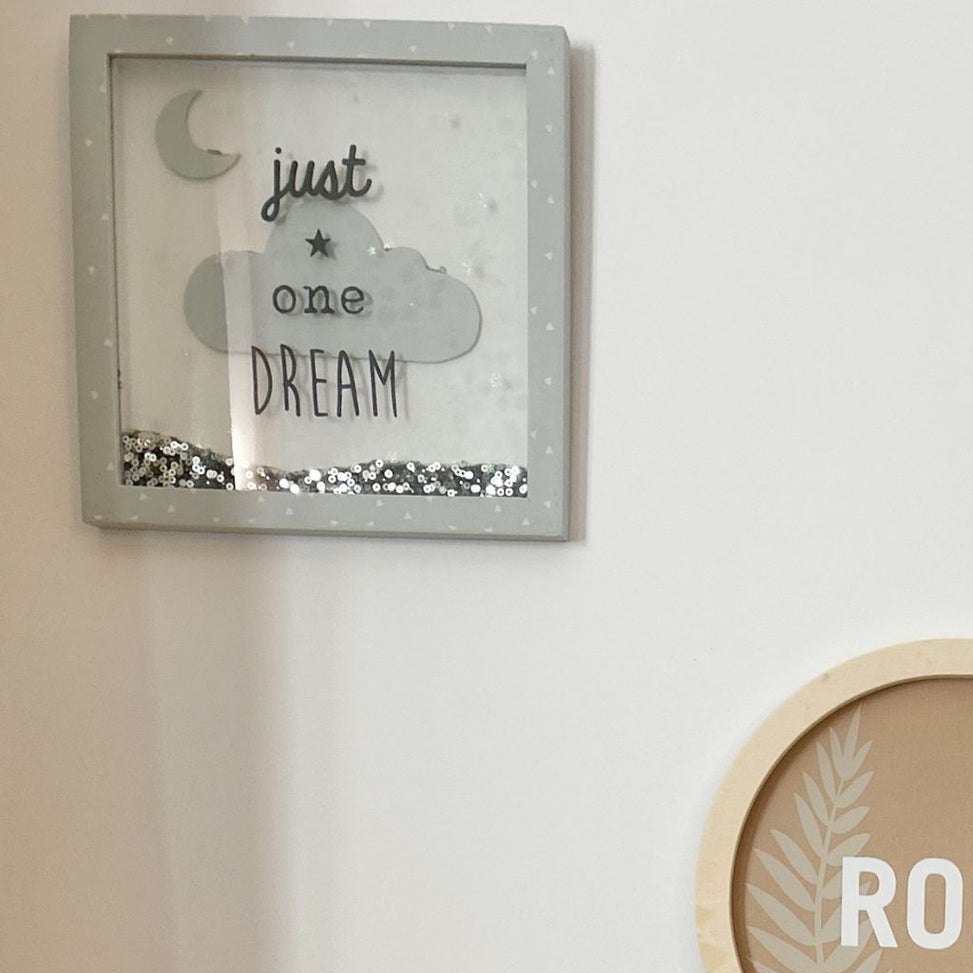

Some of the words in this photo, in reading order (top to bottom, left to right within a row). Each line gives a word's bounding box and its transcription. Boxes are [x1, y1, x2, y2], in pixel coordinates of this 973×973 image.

[261, 144, 373, 222] just
[272, 284, 365, 314] one
[251, 344, 398, 418] DREAM
